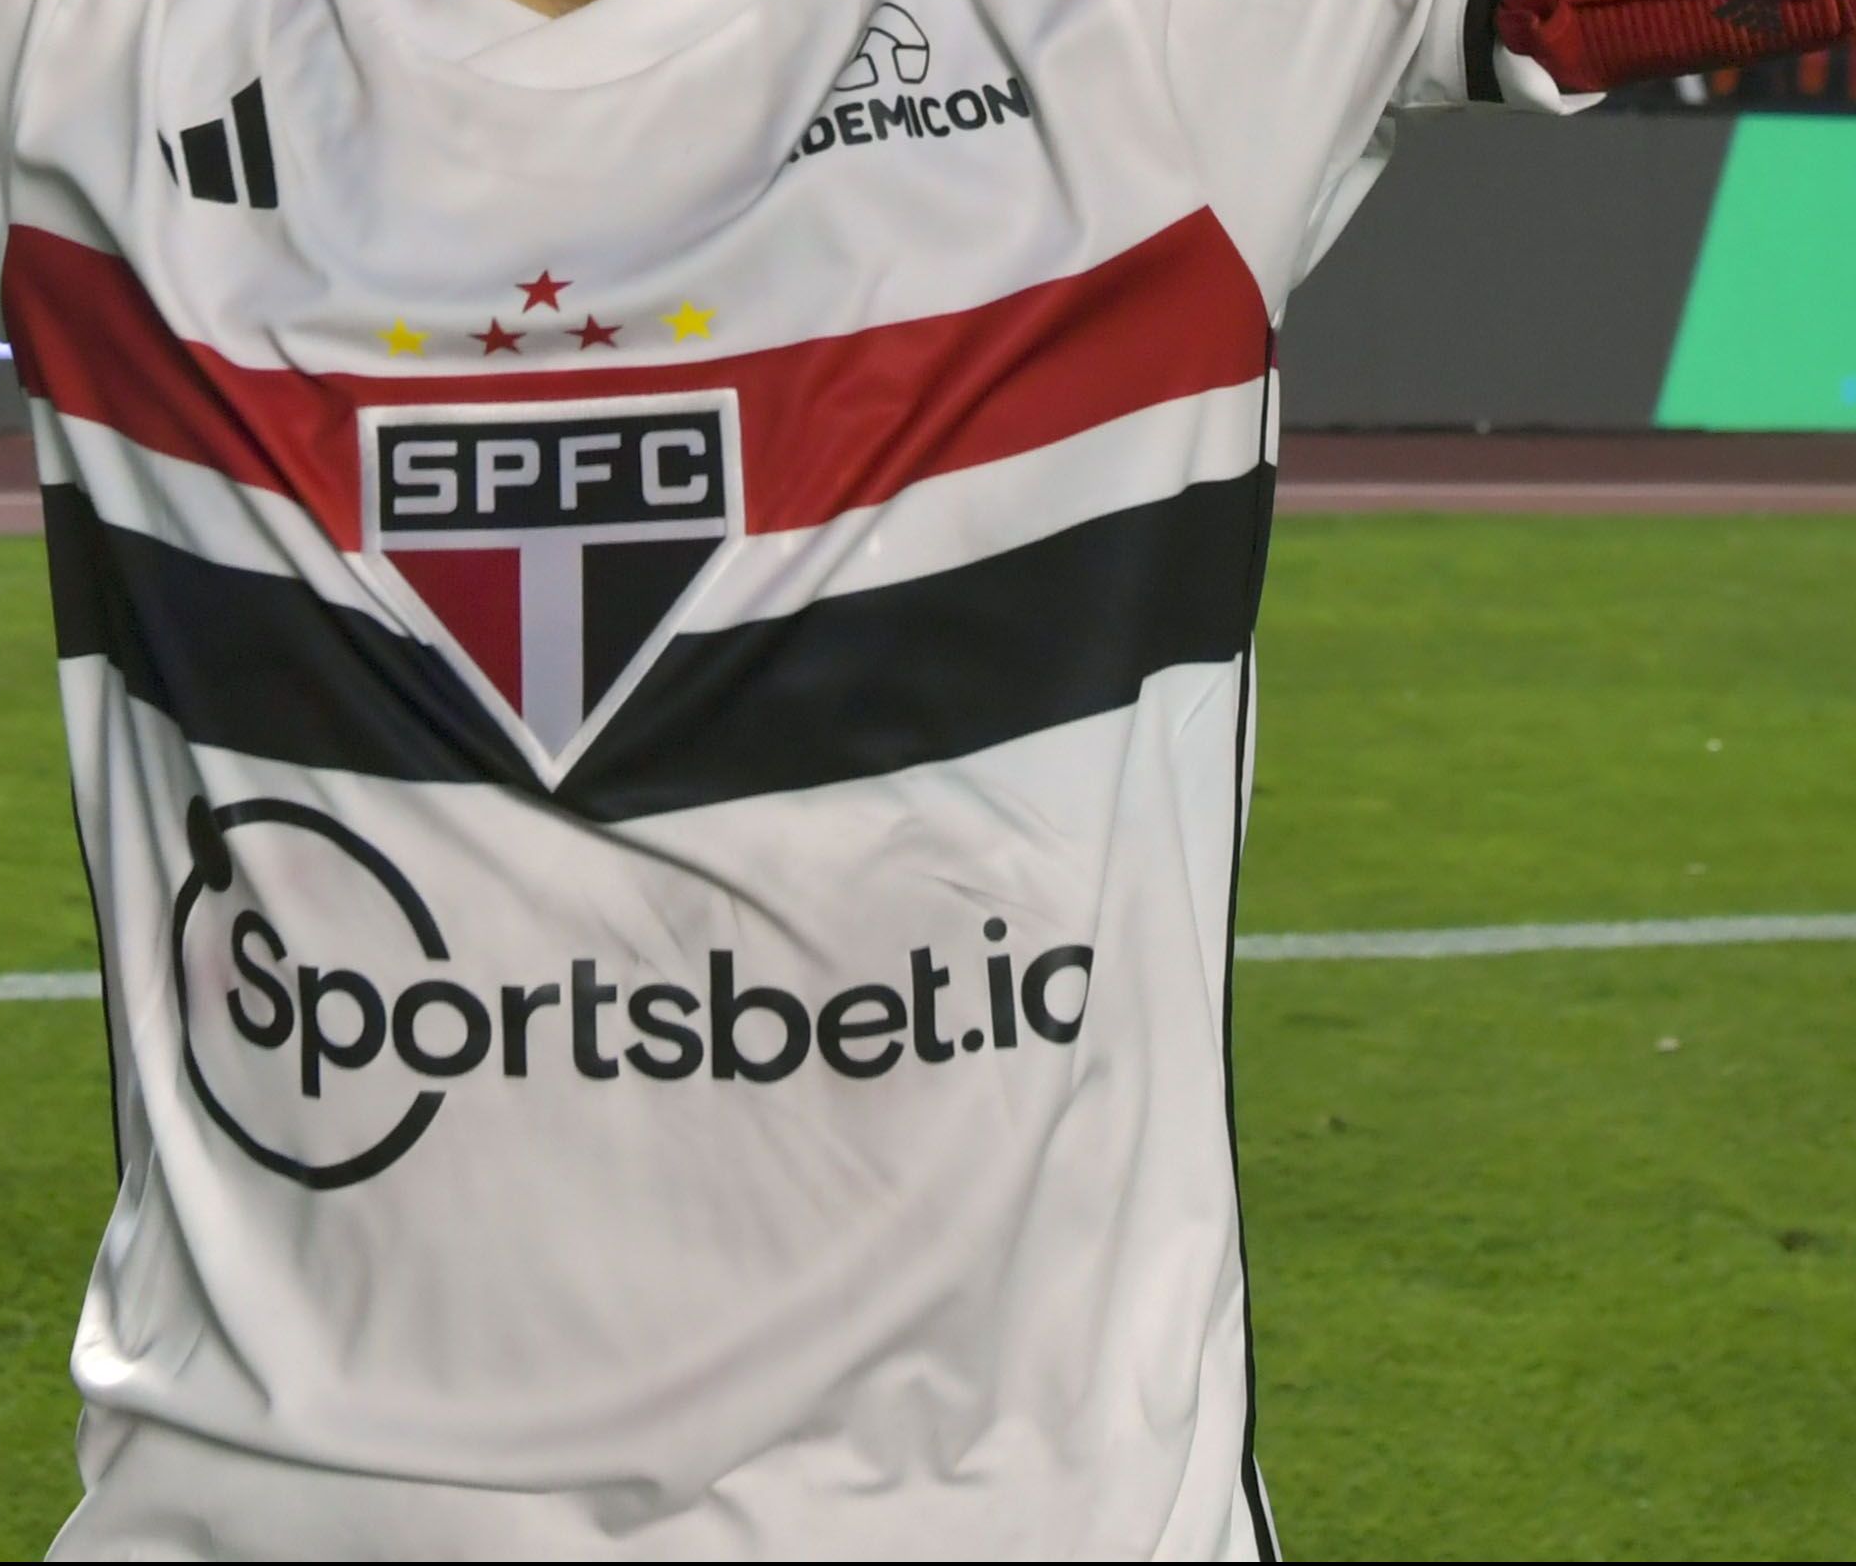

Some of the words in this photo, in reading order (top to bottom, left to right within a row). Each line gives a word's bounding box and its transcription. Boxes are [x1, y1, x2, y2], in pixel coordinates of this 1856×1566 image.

[789, 77, 1031, 162] DEMICON
[392, 429, 710, 516] SPFC
[226, 911, 1095, 1099] Sportsbet.io
